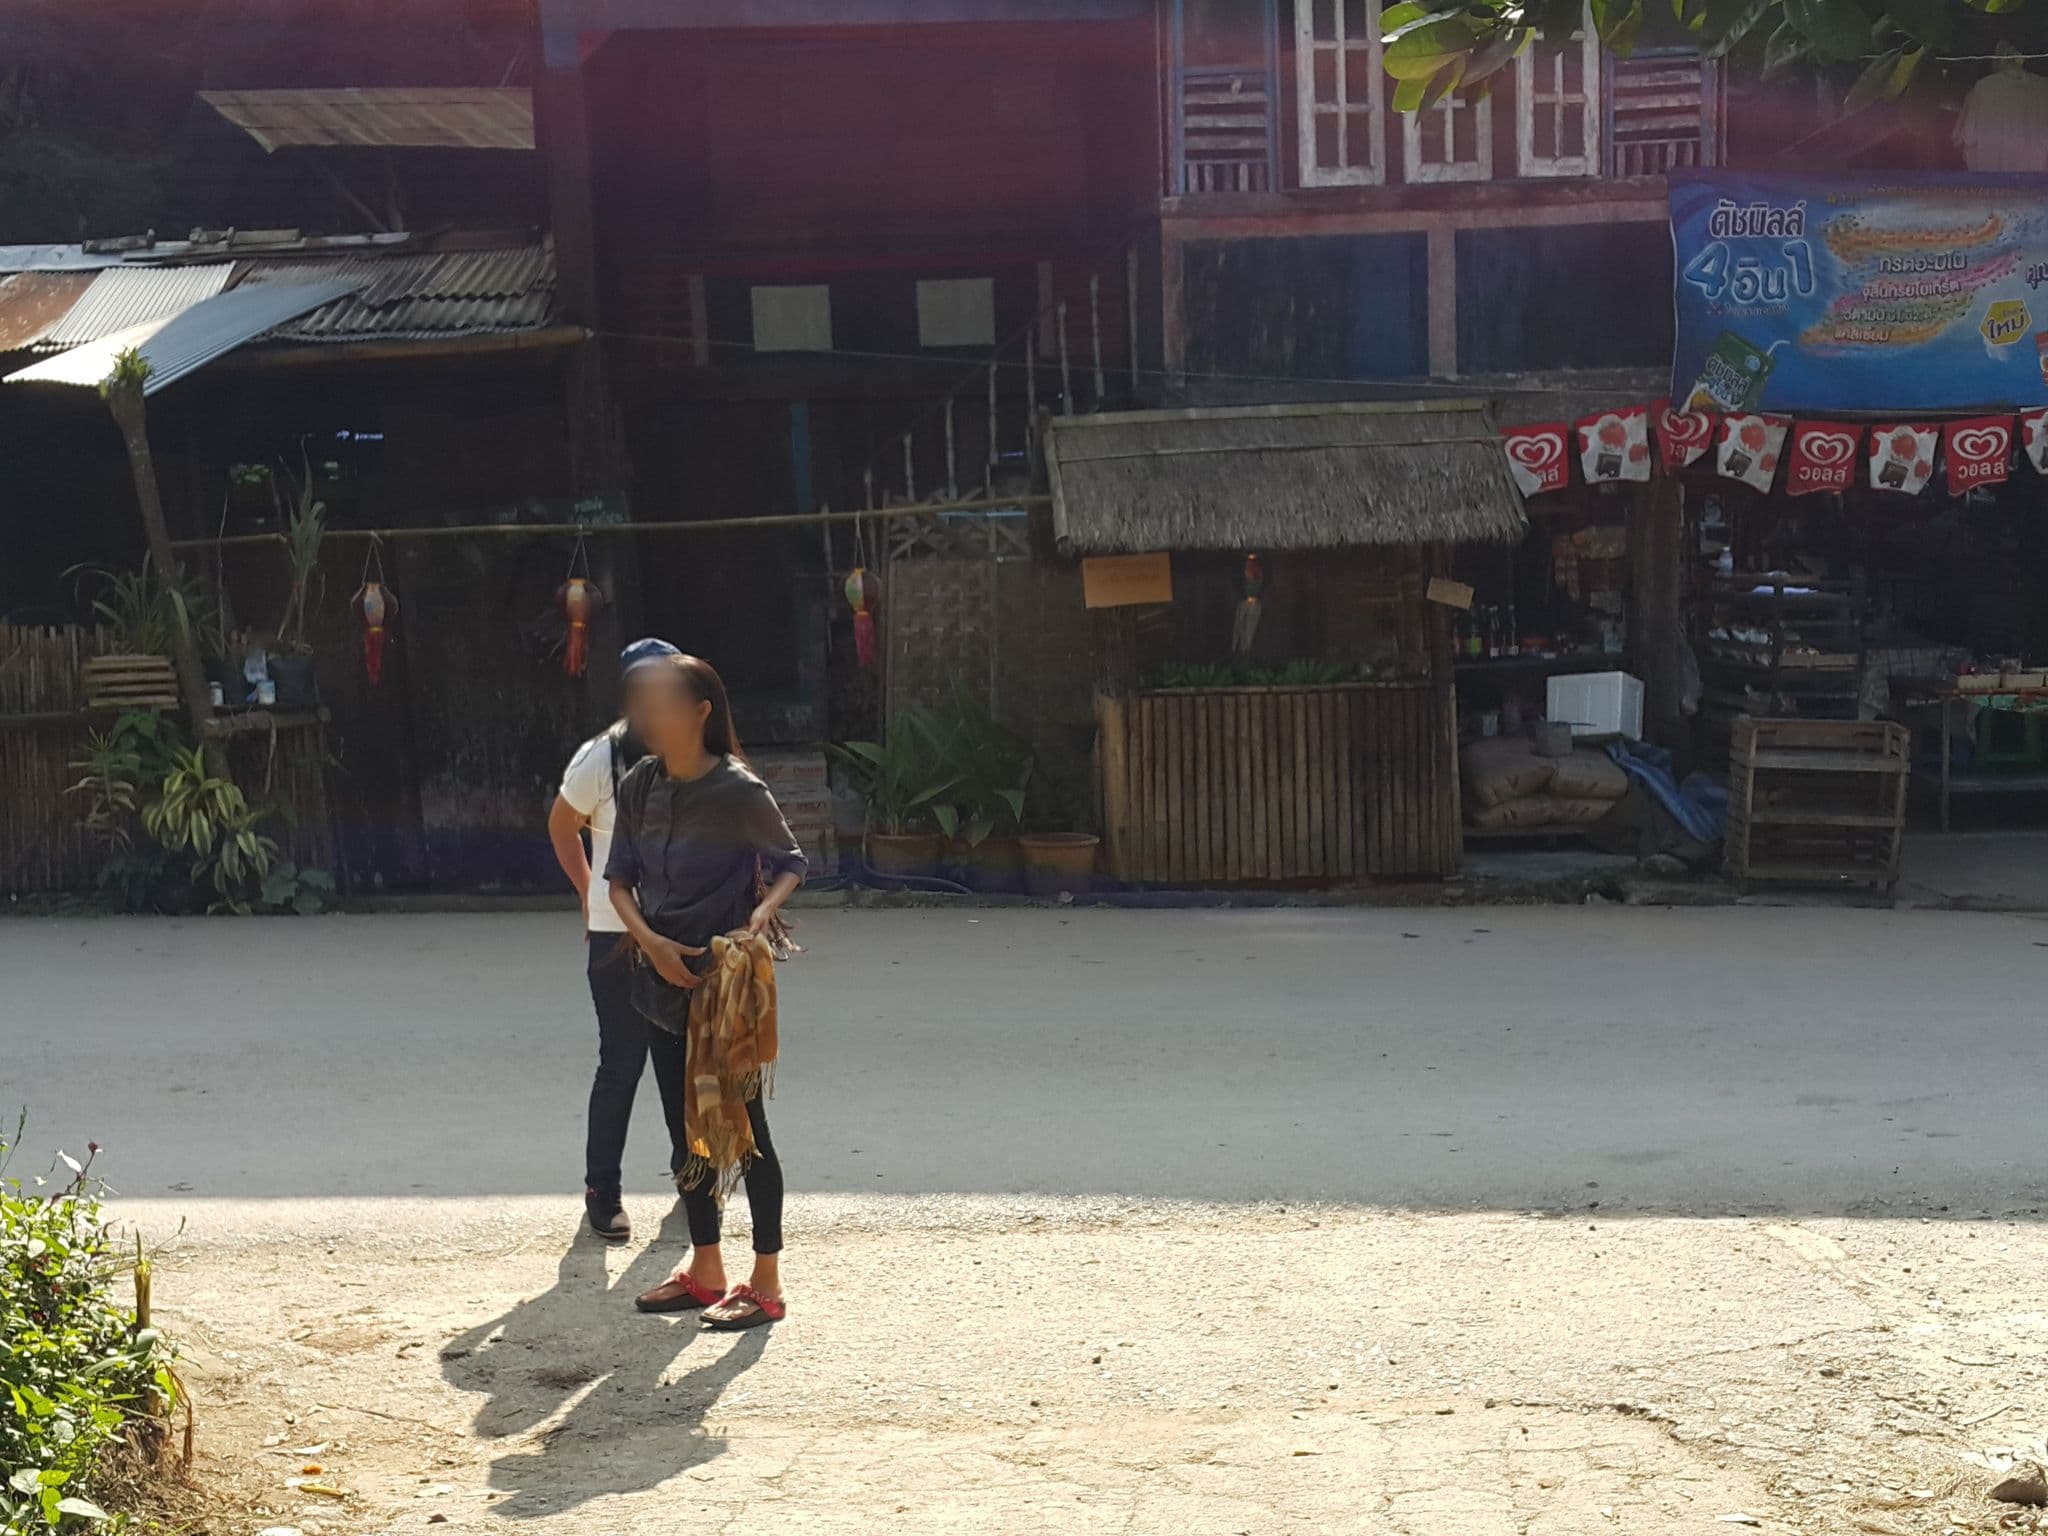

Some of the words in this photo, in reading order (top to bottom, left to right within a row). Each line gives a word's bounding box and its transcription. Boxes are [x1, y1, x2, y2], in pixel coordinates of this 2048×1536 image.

[1710, 199, 1807, 238] ดัชมิลล์
[1987, 308, 2025, 339] ใหม่
[1799, 465, 1848, 482] วอลล์
[1958, 458, 2006, 480] วอลล์
